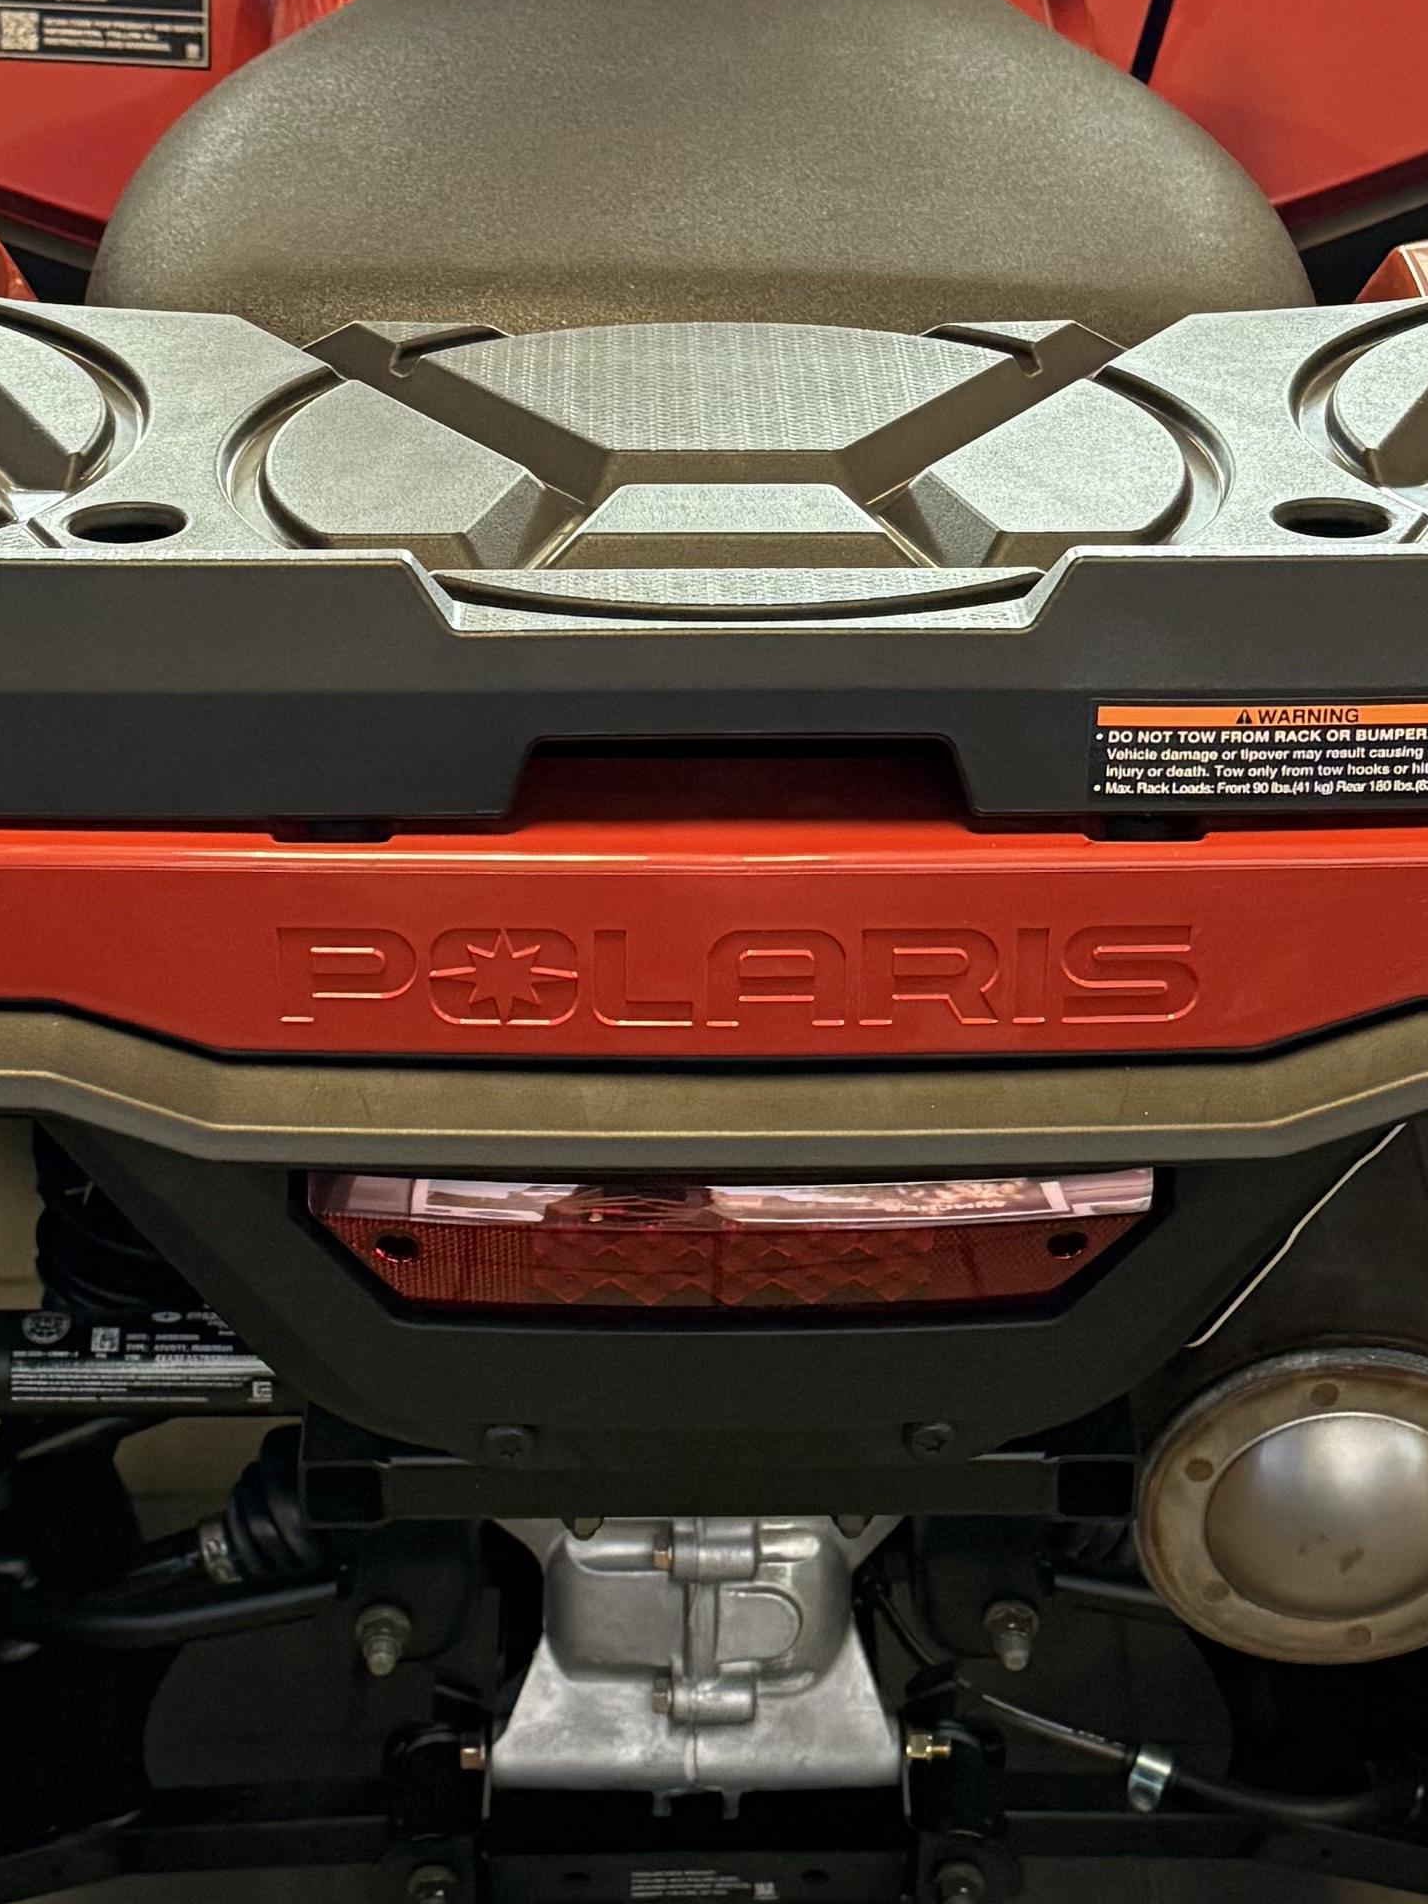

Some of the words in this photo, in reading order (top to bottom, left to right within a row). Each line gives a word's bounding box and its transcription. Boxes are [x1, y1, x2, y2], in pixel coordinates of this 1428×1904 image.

[1257, 708, 1359, 725] WARNING
[1108, 730, 1133, 743] DO
[1137, 730, 1173, 743] NOT
[1177, 730, 1216, 743] TOW
[1221, 730, 1269, 743] FROM
[1274, 729, 1321, 743] RACK
[1326, 729, 1350, 742] OR
[1106, 748, 1158, 761] Vehicle
[1160, 748, 1218, 763] damage
[1222, 749, 1237, 761] or
[1292, 749, 1322, 763] may
[1326, 747, 1366, 759] result
[1368, 746, 1423, 760] causing
[1105, 764, 1144, 780] injury
[1147, 765, 1163, 778] or
[1166, 764, 1210, 778] death.
[1214, 764, 1245, 778] Tow
[1247, 764, 1278, 780] only
[1281, 764, 1313, 777] from
[1317, 765, 1345, 776] tow
[1347, 763, 1390, 776] hooks
[1393, 763, 1408, 775] or
[1105, 782, 1134, 794] Max.
[1136, 782, 1170, 794] Rack
[1172, 782, 1215, 794] Loads:
[1217, 782, 1250, 794] Front
[1252, 782, 1269, 794] 90
[1313, 780, 1334, 795] kg)
[1336, 780, 1365, 793] Rear
[276, 925, 1201, 1027] POLARIS
